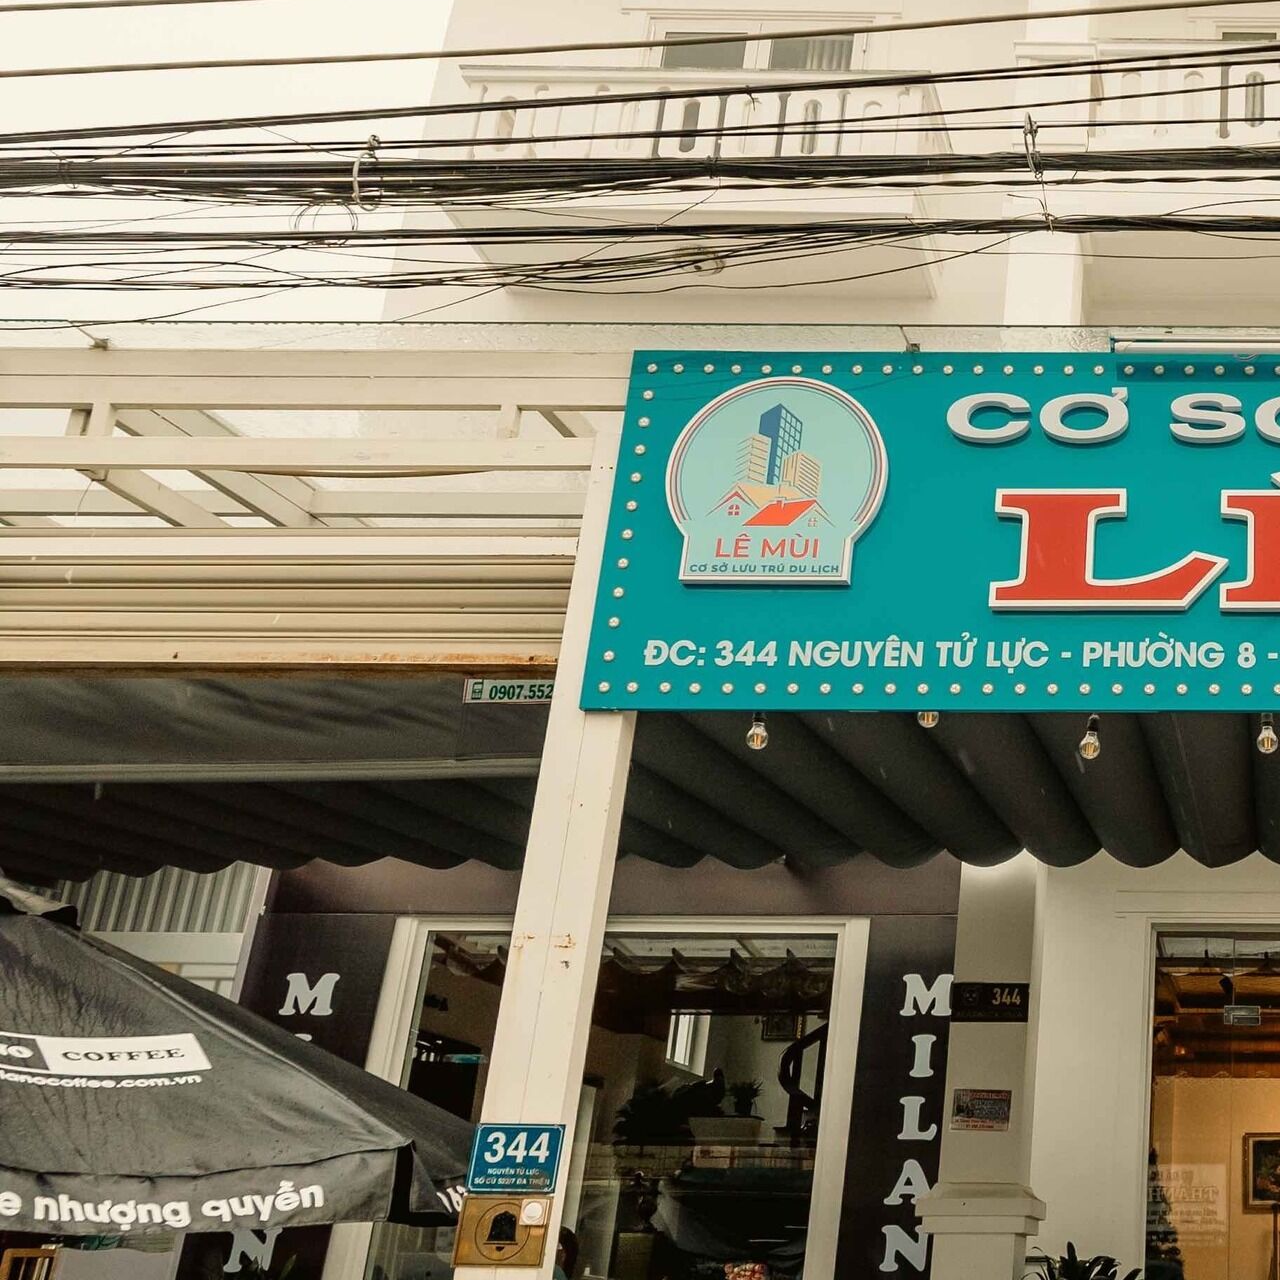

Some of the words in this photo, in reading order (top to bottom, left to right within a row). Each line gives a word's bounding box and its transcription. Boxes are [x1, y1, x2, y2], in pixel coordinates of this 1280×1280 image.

[947, 387, 1129, 445] CƠ
[715, 533, 751, 558] LÊ
[760, 533, 820, 559] MÙI
[690, 563, 707, 573] CƠ
[711, 561, 728, 573] SỞ
[732, 563, 758, 573] LƯU
[761, 562, 785, 573] TRÚ
[790, 564, 808, 573] DU
[811, 564, 840, 575] LỊCH
[643, 640, 706, 666] ĐC:
[714, 640, 778, 667] 344
[788, 634, 924, 667] NGUYÊN
[936, 632, 978, 667] TỬ
[986, 637, 1049, 674] LỰC
[1082, 631, 1225, 668] PHƯỜNG
[1237, 642, 1256, 668] 8
[489, 683, 554, 700] 0907.552
[992, 988, 1021, 1005] 344
[62, 1047, 186, 1062] COFFEE
[484, 1131, 550, 1163] 344
[33, 1194, 191, 1230] nhượng
